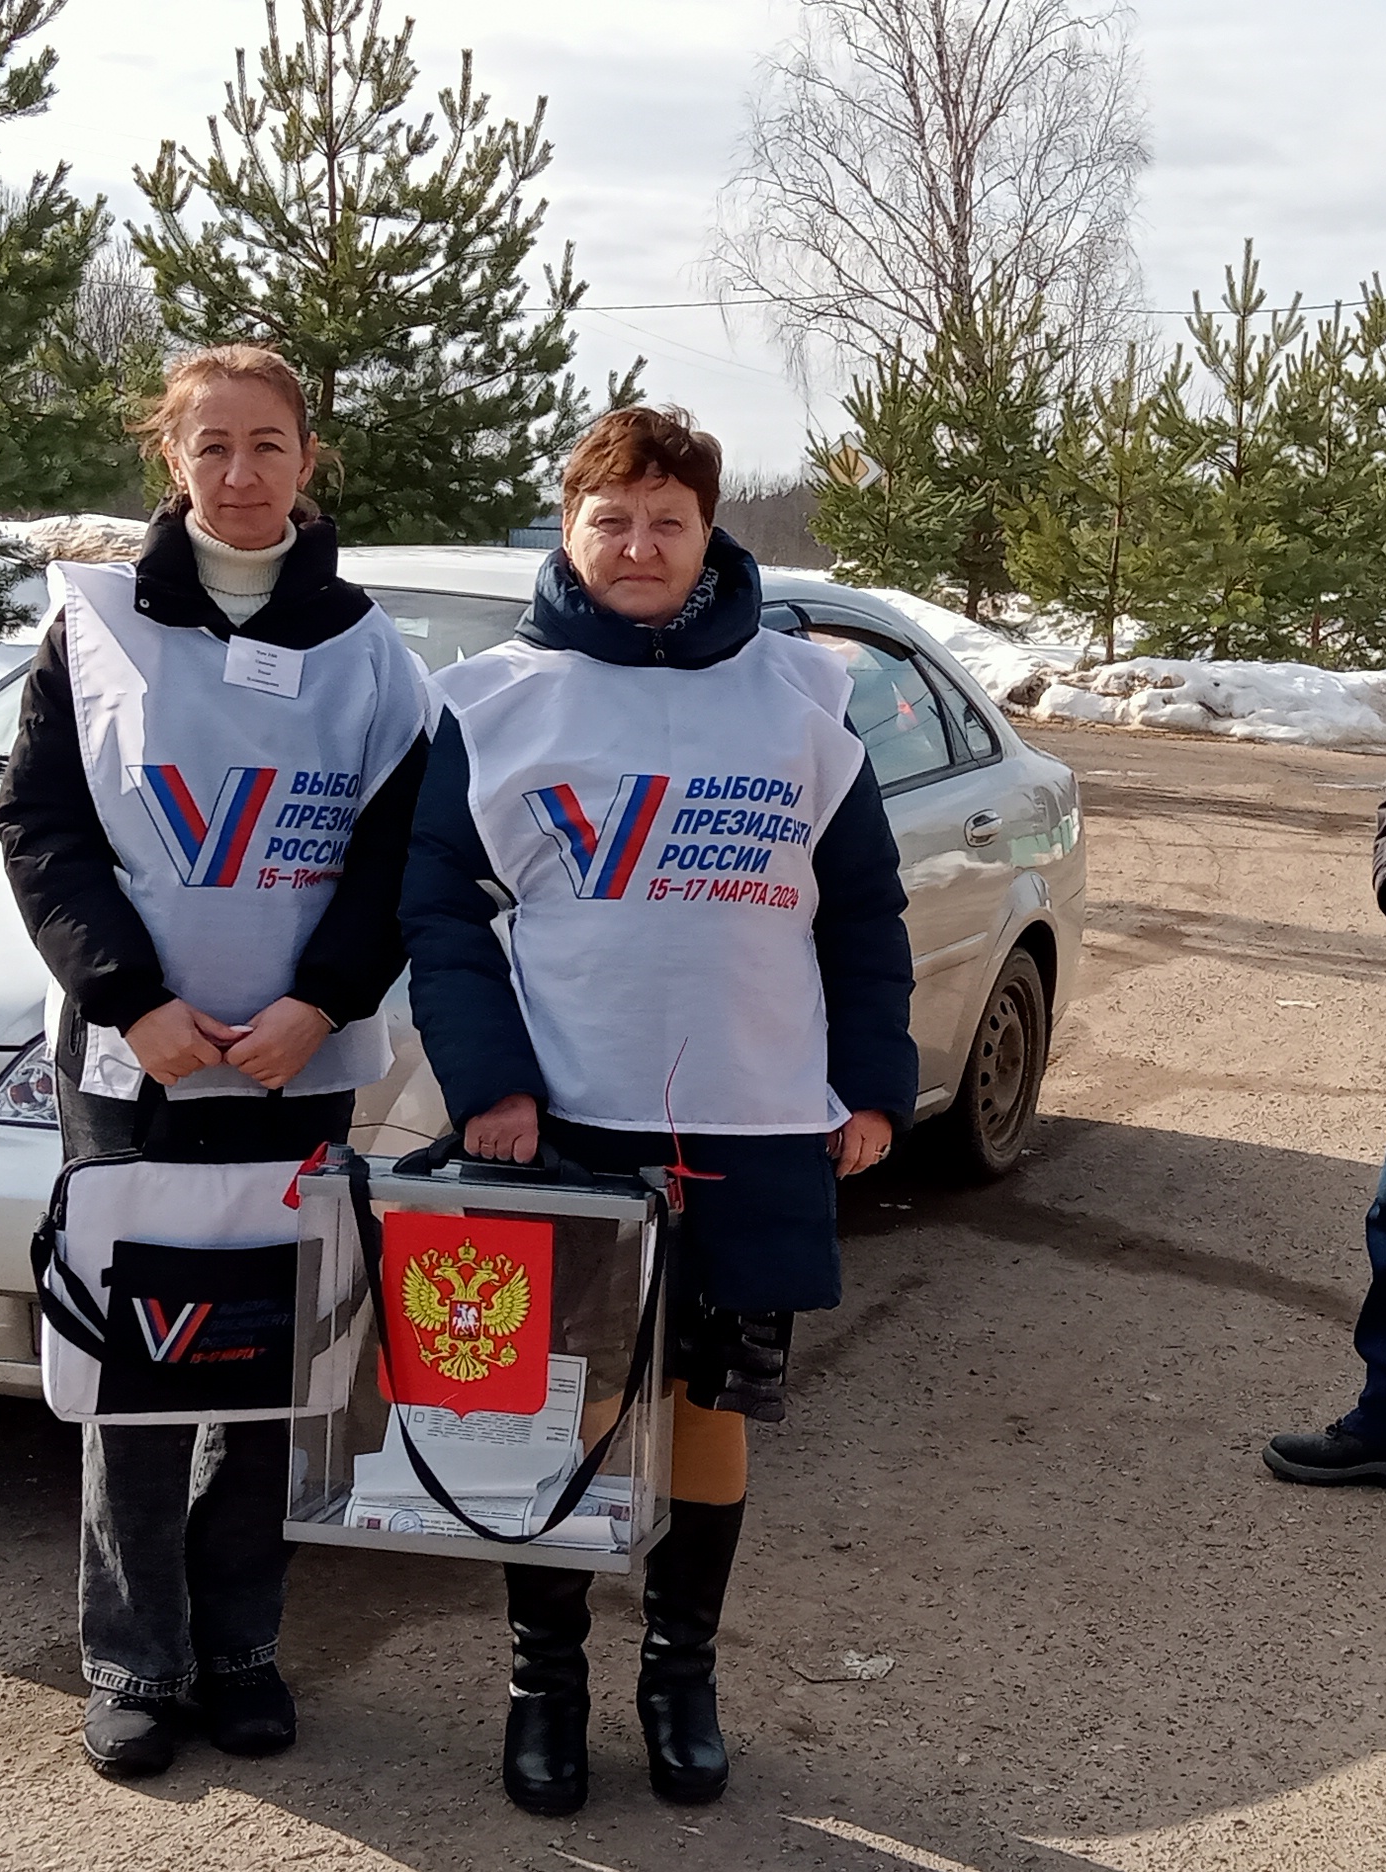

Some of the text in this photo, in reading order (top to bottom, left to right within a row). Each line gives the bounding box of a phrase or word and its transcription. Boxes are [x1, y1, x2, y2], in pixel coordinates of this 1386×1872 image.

[685, 776, 803, 809] ВЫБОРЫ
[276, 804, 356, 835] ПРЕЗИ
[656, 843, 772, 873] РОССИИ
[706, 879, 769, 905] МАРТА
[768, 884, 800, 910] 2024
